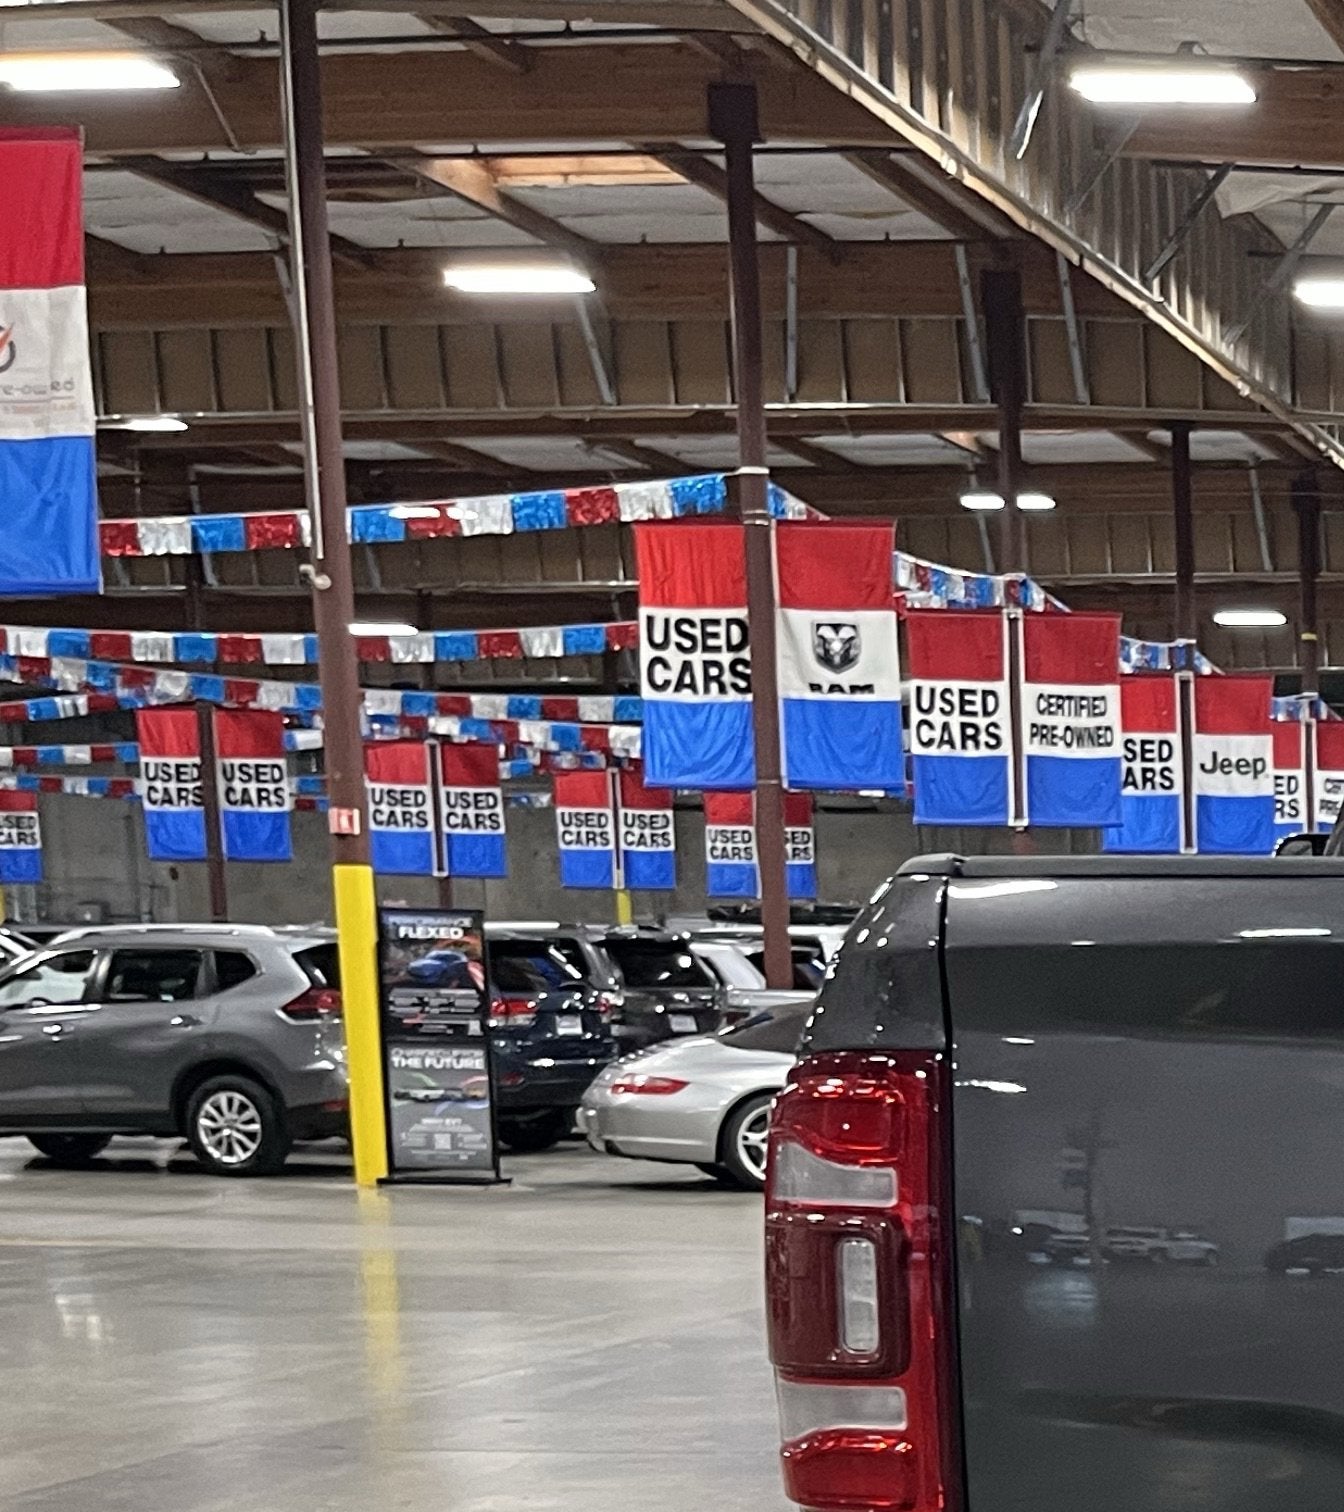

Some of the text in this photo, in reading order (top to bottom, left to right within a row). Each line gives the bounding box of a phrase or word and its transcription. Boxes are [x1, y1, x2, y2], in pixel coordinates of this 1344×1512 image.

[646, 615, 749, 654] USED
[647, 656, 751, 695] CARS
[916, 686, 999, 717] USED
[1037, 693, 1107, 718] CERTIFIED
[916, 719, 1002, 750] CARS
[1029, 723, 1114, 749] PRE-OWNED
[1123, 738, 1173, 763] SED
[144, 762, 201, 783] USED
[222, 763, 284, 784] USED
[1200, 751, 1267, 779] Jeep
[1123, 767, 1174, 790] ARS
[1274, 775, 1299, 795] ED
[146, 786, 202, 807] CARS
[224, 787, 286, 807] CARS
[371, 788, 426, 808] USED
[446, 791, 498, 810] USED
[372, 809, 428, 828] CARS
[1275, 799, 1299, 818] RS
[0, 815, 37, 830] SED
[446, 812, 500, 830] CARS
[560, 812, 609, 829] USED
[623, 812, 670, 830] USED
[561, 831, 610, 847] CARS
[623, 831, 671, 848] CARS
[708, 829, 752, 844] USED
[784, 830, 811, 845] SED
[709, 846, 753, 861] CARS
[398, 926, 464, 939] FLEXED
[391, 1056, 485, 1069] THE FUTURE
